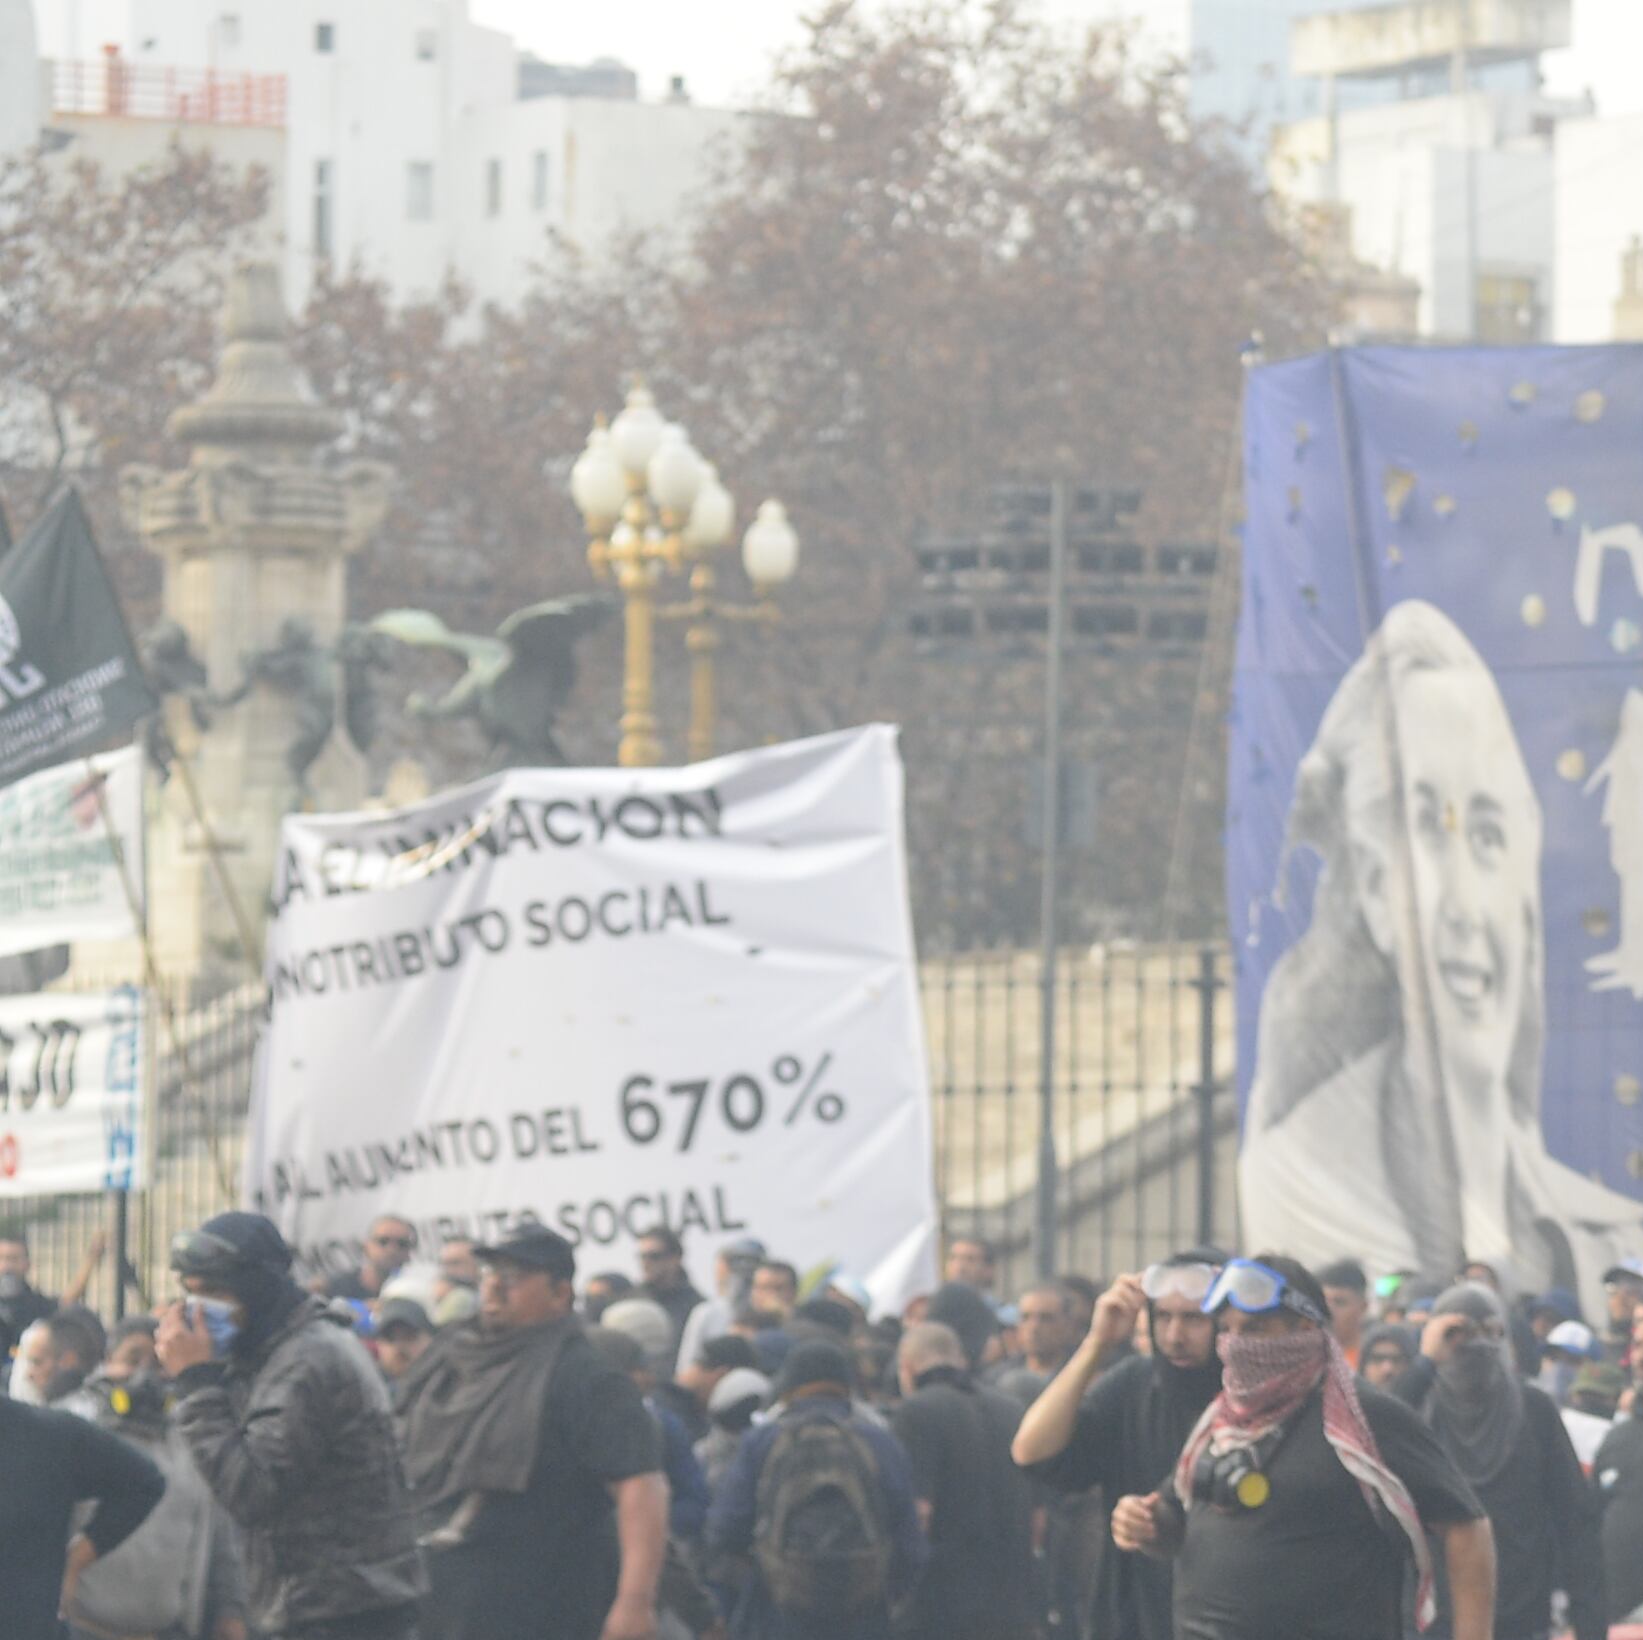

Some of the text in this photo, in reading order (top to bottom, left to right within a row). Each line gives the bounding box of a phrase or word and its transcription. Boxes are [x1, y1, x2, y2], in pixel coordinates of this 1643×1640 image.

[525, 880, 730, 947] SOCIAL
[511, 1106, 600, 1162] DEL
[618, 1052, 846, 1152] 670%
[557, 1185, 747, 1248] SOCIAL
